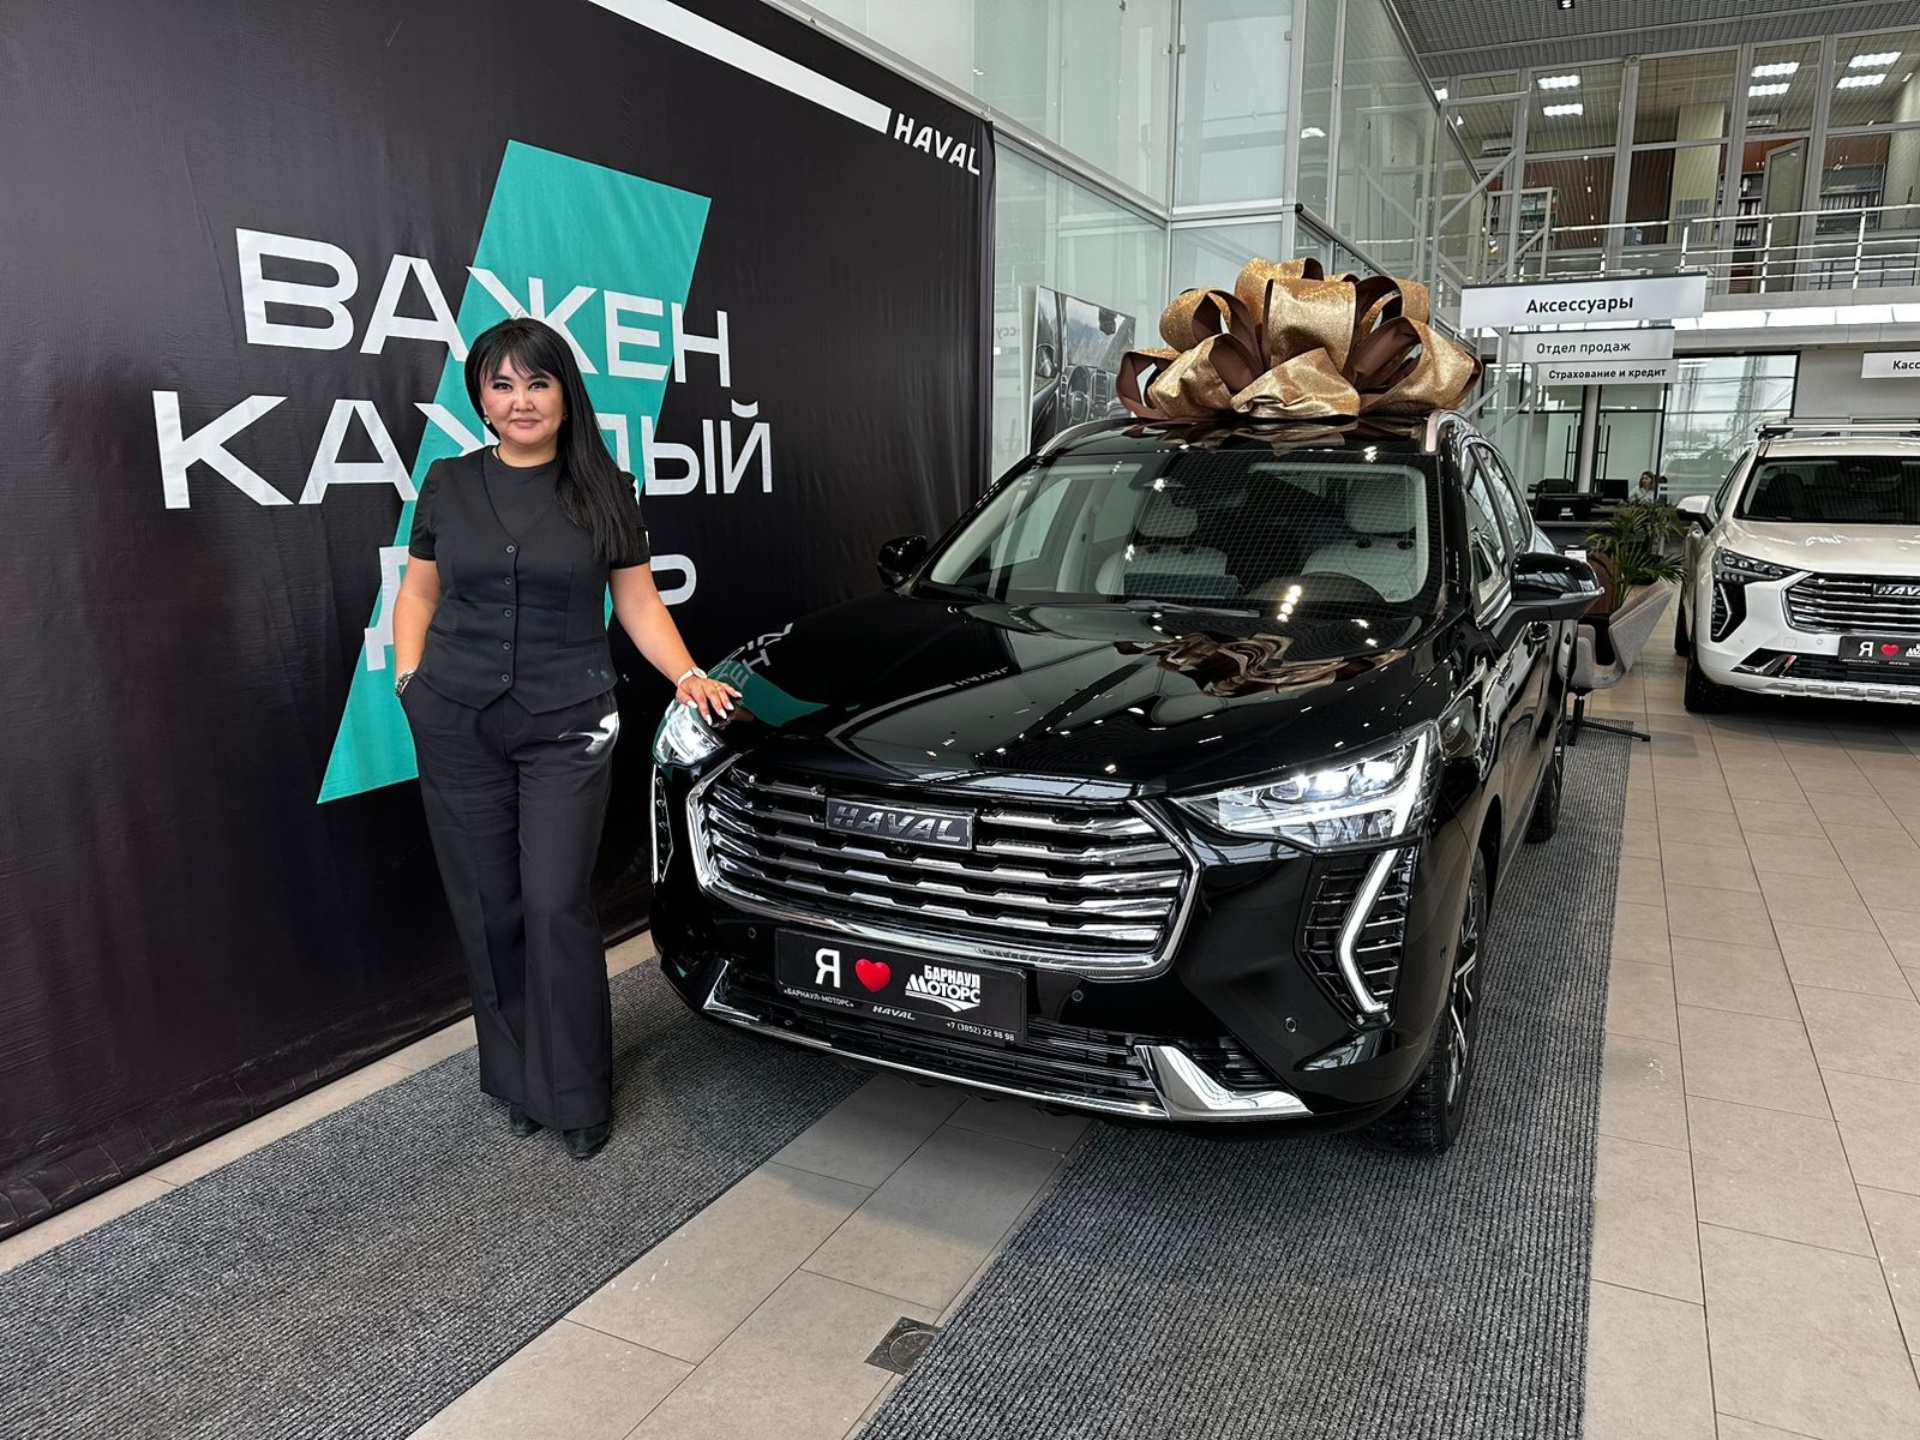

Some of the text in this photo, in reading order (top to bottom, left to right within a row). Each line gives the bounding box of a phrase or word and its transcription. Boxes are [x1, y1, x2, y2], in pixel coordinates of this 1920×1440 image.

[894, 112, 981, 176] HAVAL
[235, 227, 732, 388] ВАЖЕН
[1525, 297, 1634, 314] Аксессуары
[1536, 342, 1631, 355] Отдел продаж
[1548, 368, 1667, 381] Страхование и кредит
[1858, 641, 1875, 658] Я
[832, 805, 962, 843] HAVAL
[814, 947, 841, 989] Я
[923, 964, 981, 990] БАРНАУЛ
[905, 973, 981, 1004] МОТОРС
[871, 1005, 916, 1021] HAVAL
[946, 1021, 956, 1029] +7
[957, 1021, 981, 1035] (3852)
[982, 1028, 992, 1037] 22
